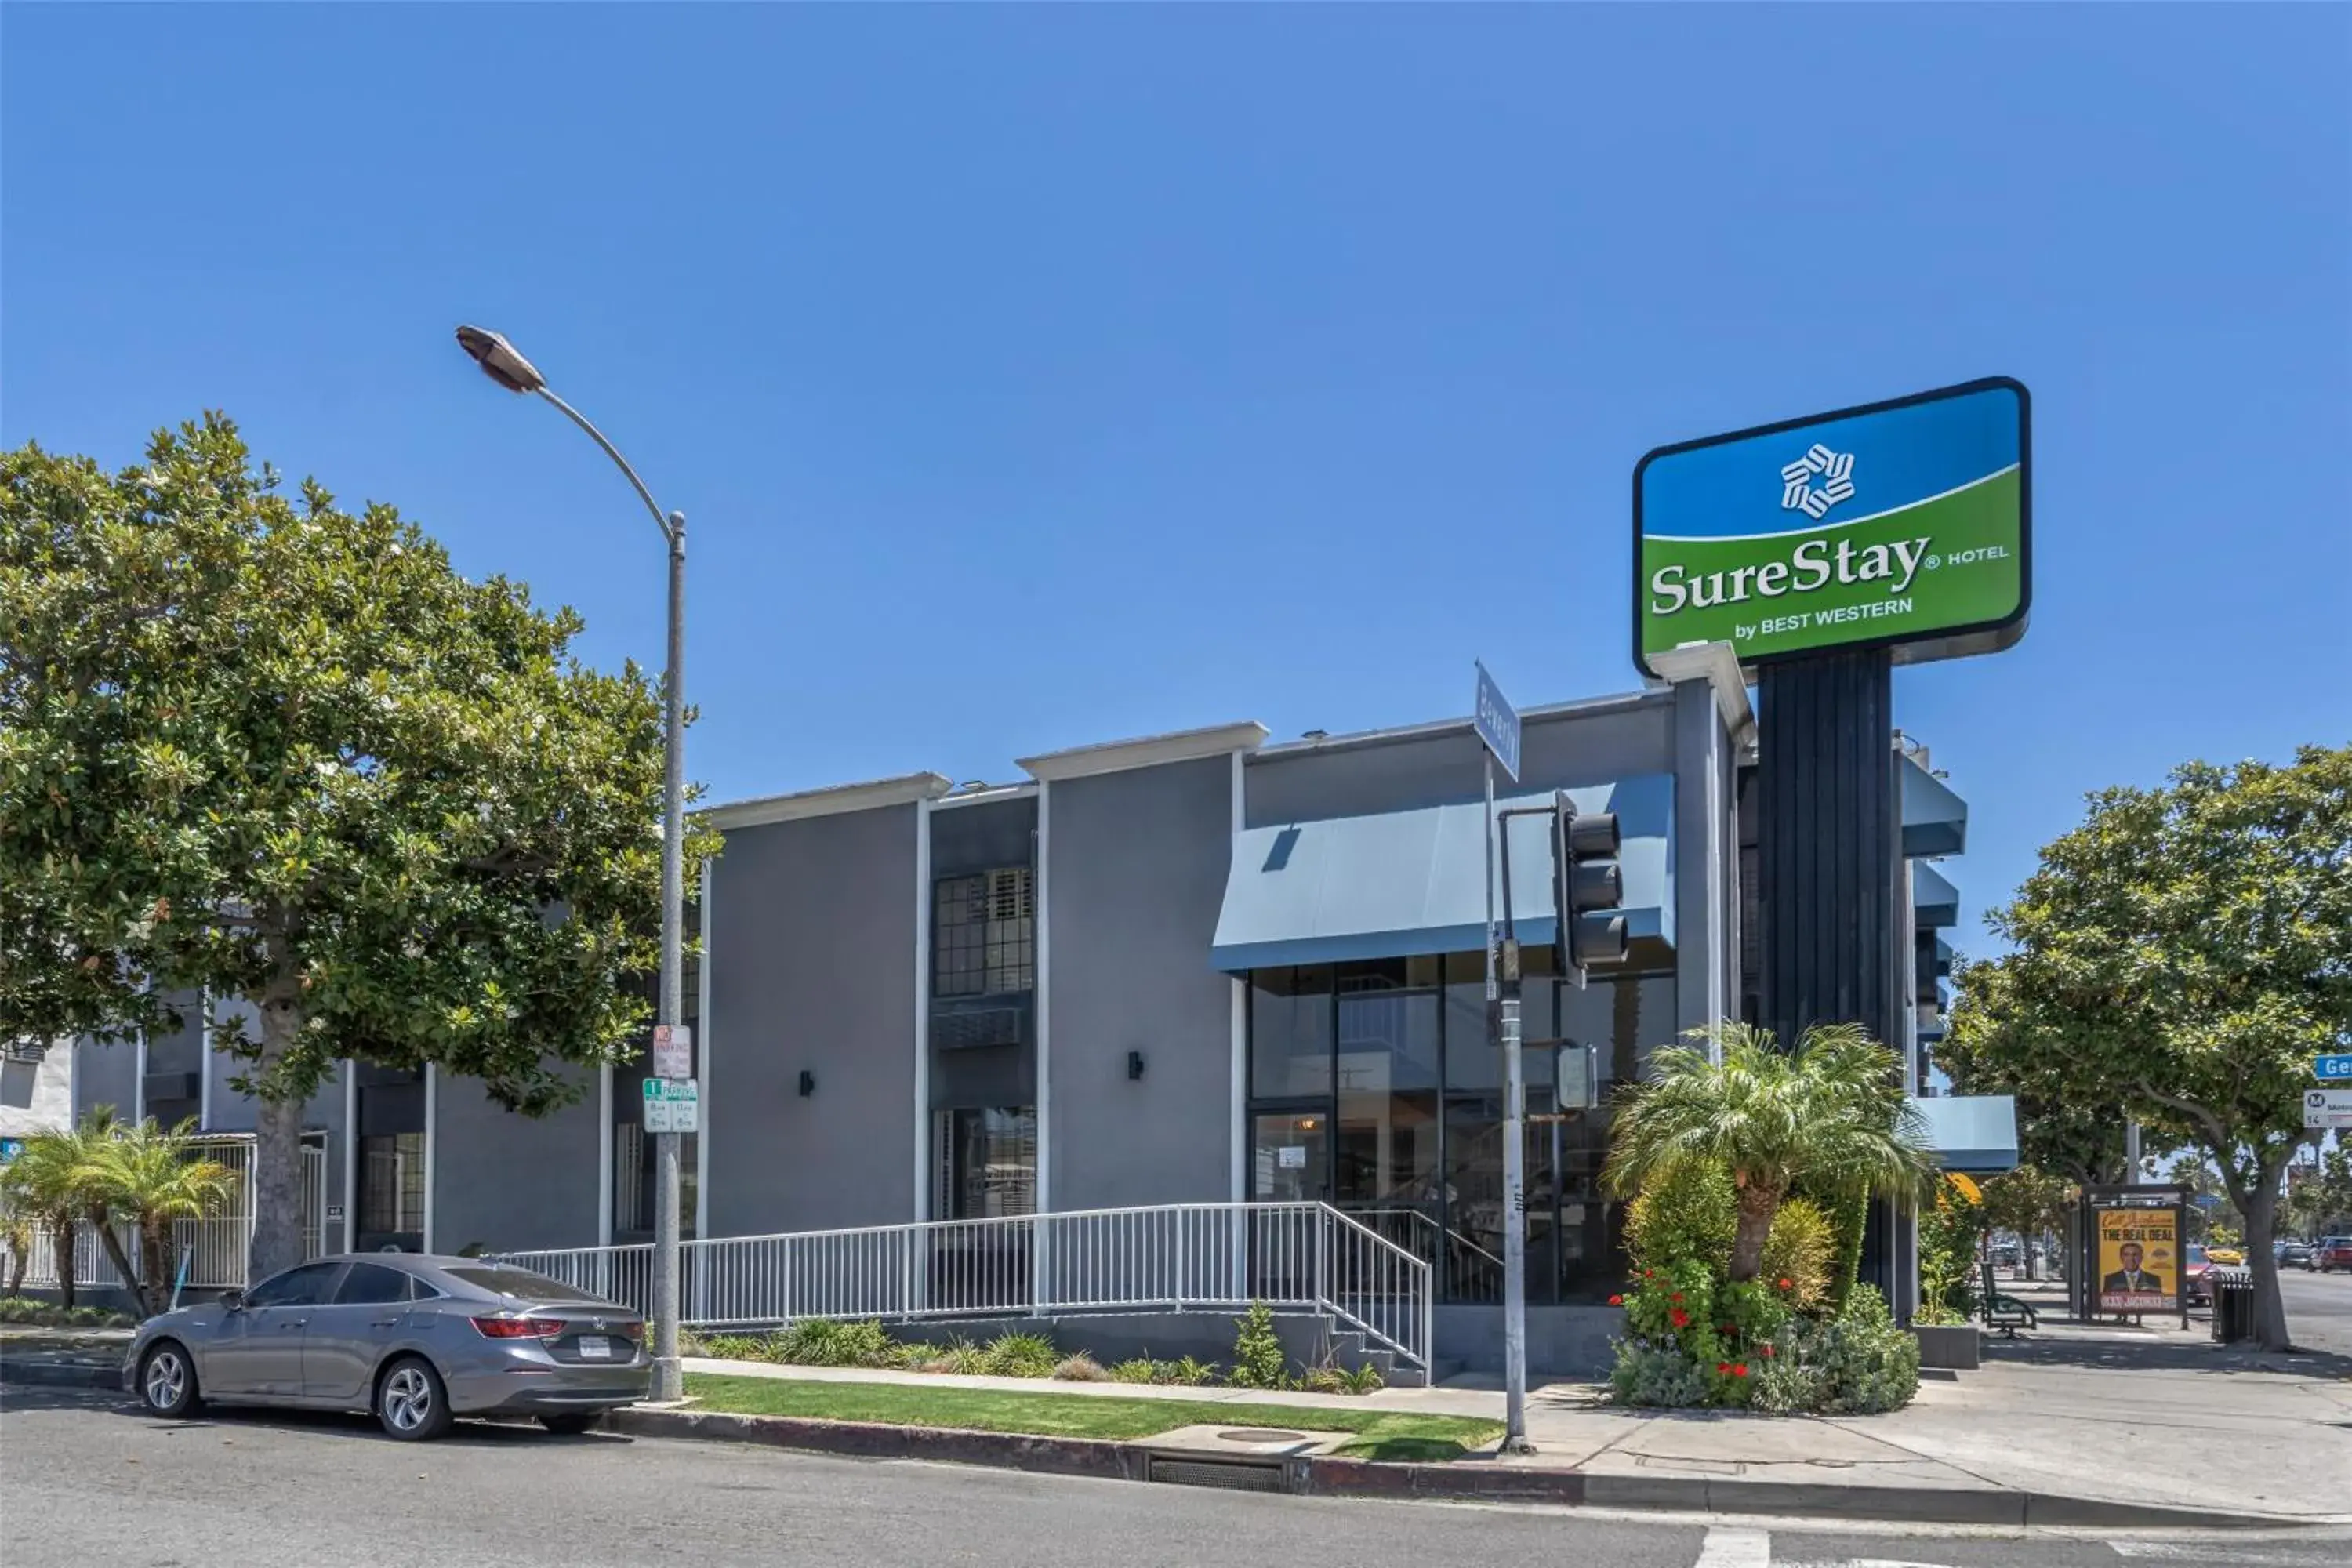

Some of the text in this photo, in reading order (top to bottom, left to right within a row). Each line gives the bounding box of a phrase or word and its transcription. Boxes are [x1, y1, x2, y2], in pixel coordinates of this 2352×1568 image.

[1947, 545, 2009, 566] HOTEL
[1734, 598, 1913, 641] by BEST WESTERN
[2325, 1059, 2352, 1074] Ge
[2103, 1229, 2174, 1242] THE REAL DEAL
